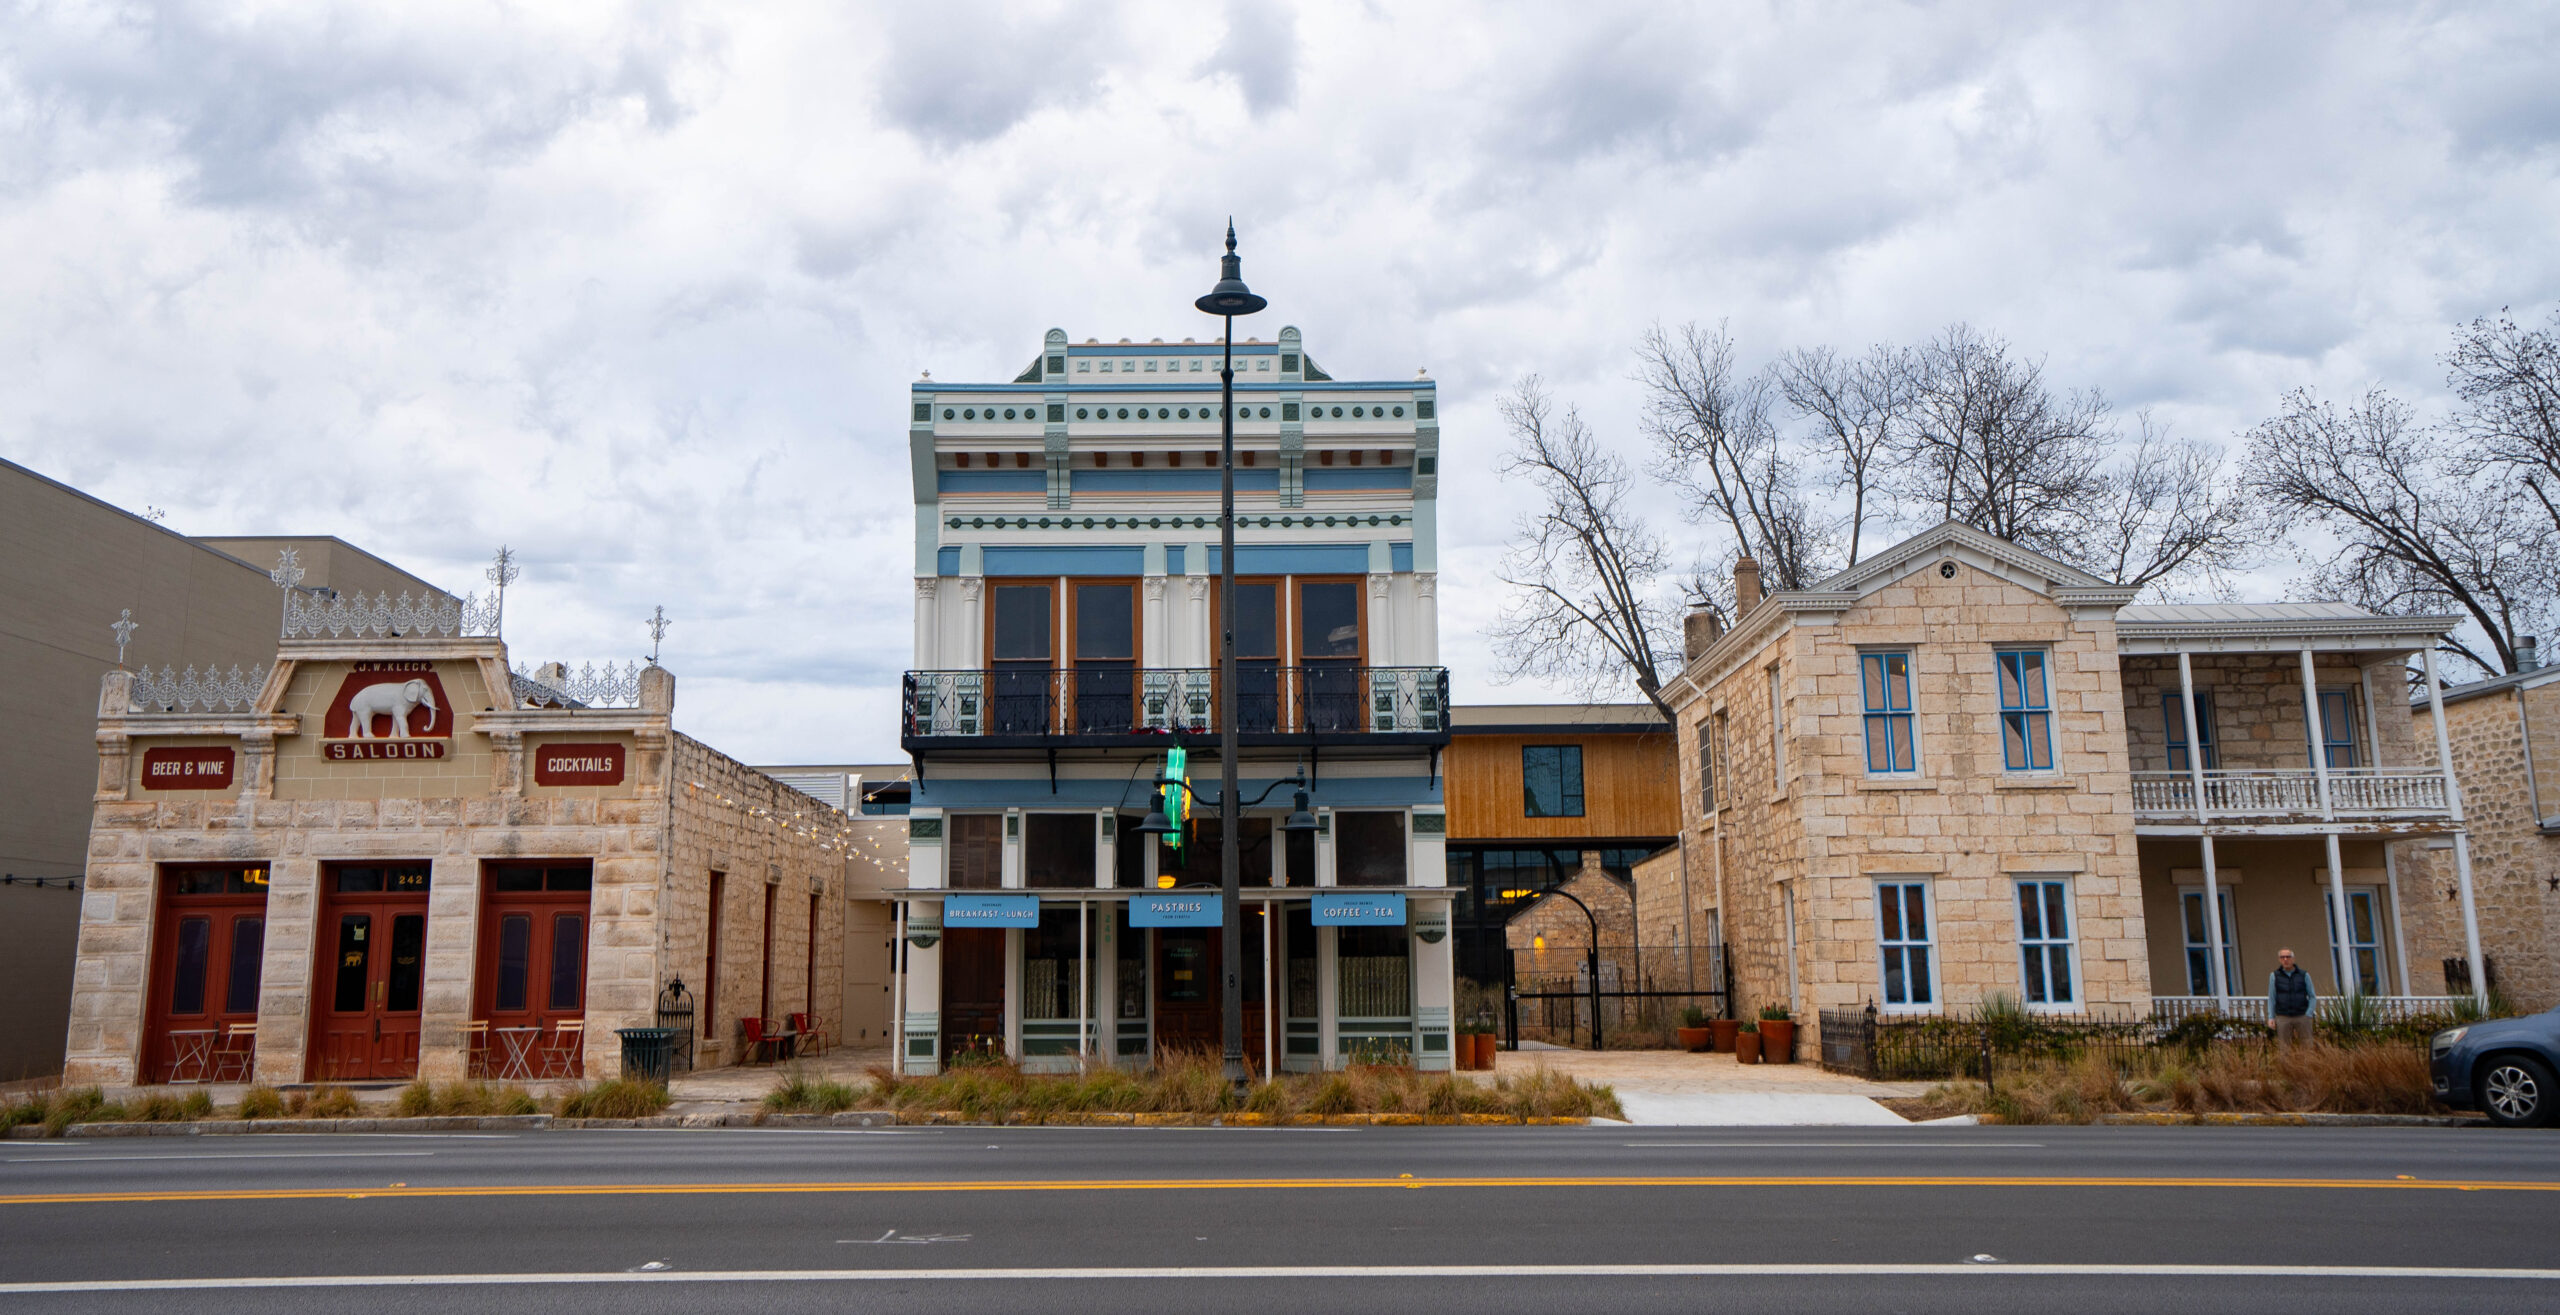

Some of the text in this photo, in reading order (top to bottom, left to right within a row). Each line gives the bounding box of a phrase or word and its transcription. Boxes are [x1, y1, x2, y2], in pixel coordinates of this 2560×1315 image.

[334, 743, 436, 759] SALOON
[152, 761, 225, 776] BEER & WINE
[548, 757, 612, 772] COCKTAILS
[399, 875, 423, 885] 242
[1151, 903, 1202, 912] PASTRIES
[1323, 907, 1394, 918] COFFEE TEA
[949, 910, 1034, 919] BREAKFAST LUNCH
